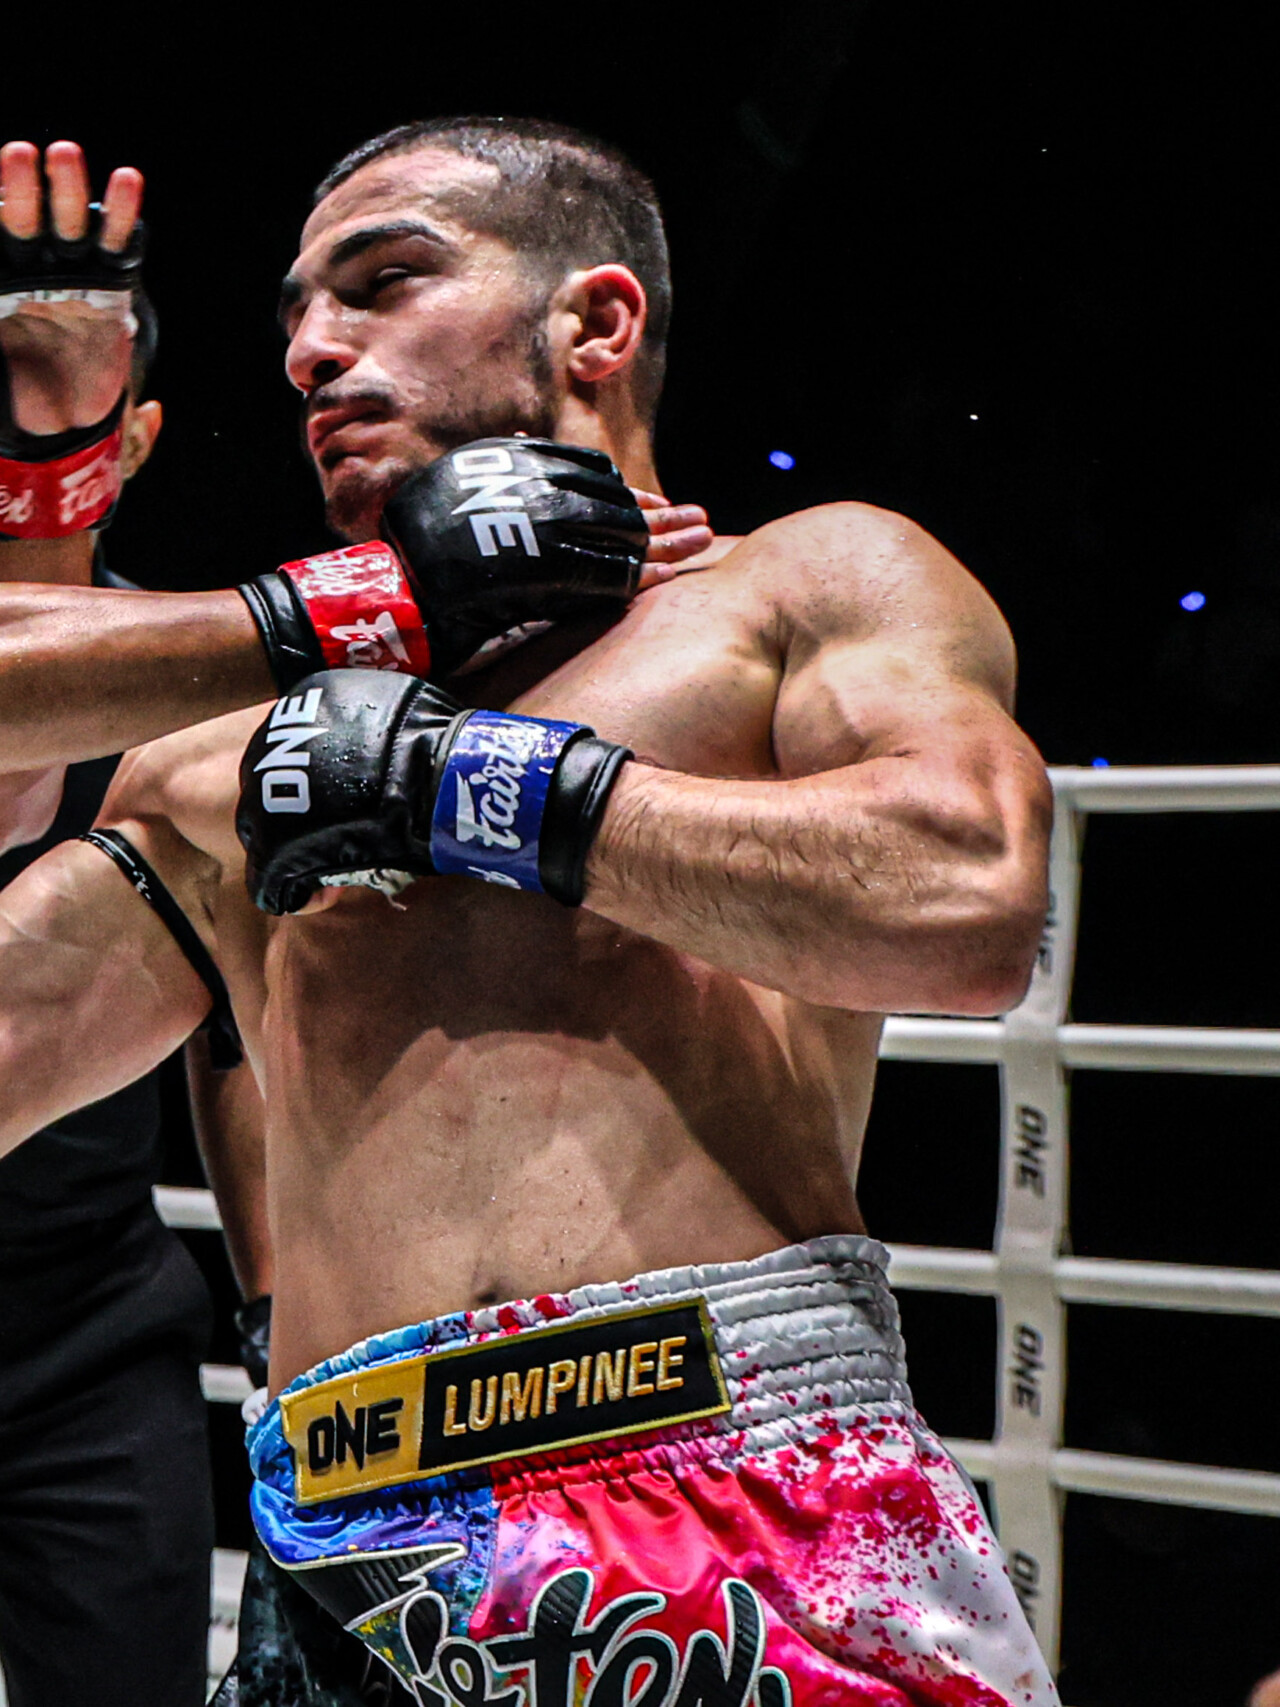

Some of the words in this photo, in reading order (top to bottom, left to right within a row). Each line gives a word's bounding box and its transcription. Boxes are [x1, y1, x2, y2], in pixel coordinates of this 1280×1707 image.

[452, 447, 541, 558] ONE
[253, 687, 324, 815] ONE
[1014, 1103, 1048, 1199] ONE
[307, 1397, 403, 1475] ONE
[442, 1335, 688, 1437] LUMPINEE
[1009, 1322, 1045, 1417] ONE
[1010, 1550, 1042, 1634] ON
